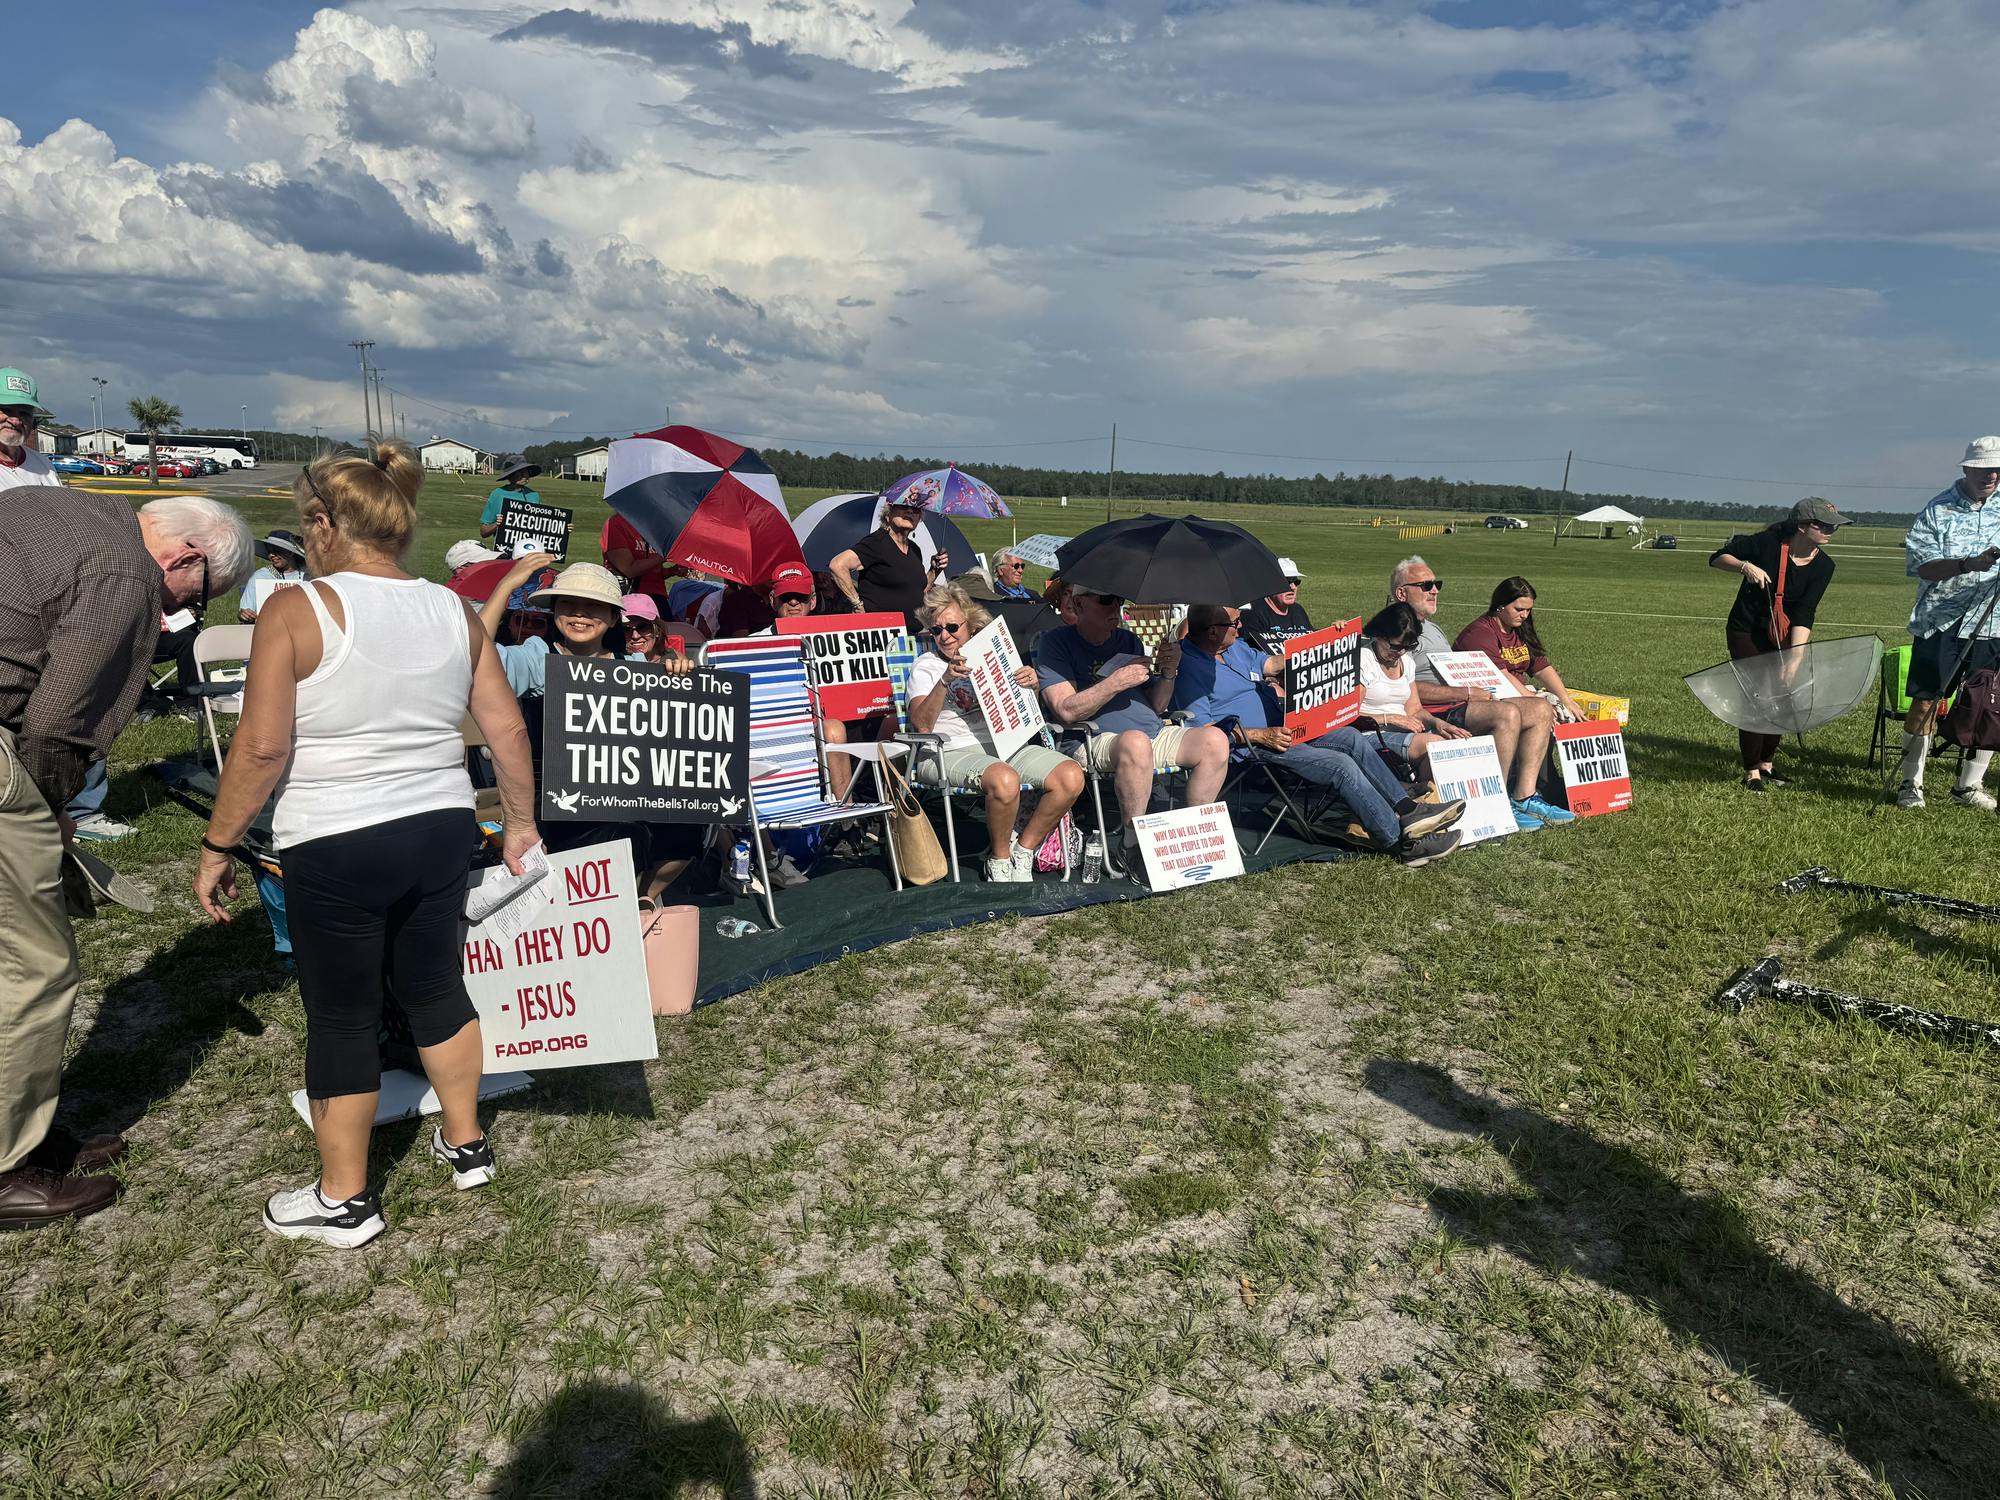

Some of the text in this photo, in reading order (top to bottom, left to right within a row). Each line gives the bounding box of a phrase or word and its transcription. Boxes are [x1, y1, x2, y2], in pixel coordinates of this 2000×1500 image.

[509, 501, 566, 518] We Oppose The
[505, 511, 566, 535] EXECUTION
[693, 556, 734, 574] NAUTICA
[992, 635, 1002, 654] THIS
[1292, 642, 1331, 670] DEATH
[1334, 632, 1358, 656] ROW
[999, 652, 1010, 674] THAN
[1297, 653, 1354, 690] IS MENTAL
[568, 661, 732, 694] We Oppose The
[984, 650, 1020, 730] DEATH PENALTY
[973, 665, 1005, 734] ABOLISH THE
[1017, 698, 1026, 713] ARE
[1293, 672, 1356, 714] TORTURE
[565, 693, 735, 743] EXECUTION
[1562, 735, 1622, 760] THOU SHALT
[566, 743, 732, 789] THIS WEEK
[1576, 758, 1622, 783] NOT KILL!
[1441, 775, 1503, 802] NOT IN MY NAME
[581, 795, 719, 813] ForWhomTheBellsToll.org
[1200, 805, 1225, 816] FADP.ORG
[1153, 821, 1218, 842] WHY DO WE KILL PEOPLE
[1154, 835, 1224, 857] WHO KILL PEOPLE TO SHOW
[1161, 849, 1226, 871] THAT KILLING IS WRONG?
[565, 858, 611, 901] NOT
[514, 925, 563, 967] THEY
[573, 917, 611, 957] DO
[517, 981, 576, 1030] JESUS
[495, 1034, 588, 1058] FADP.ORG
